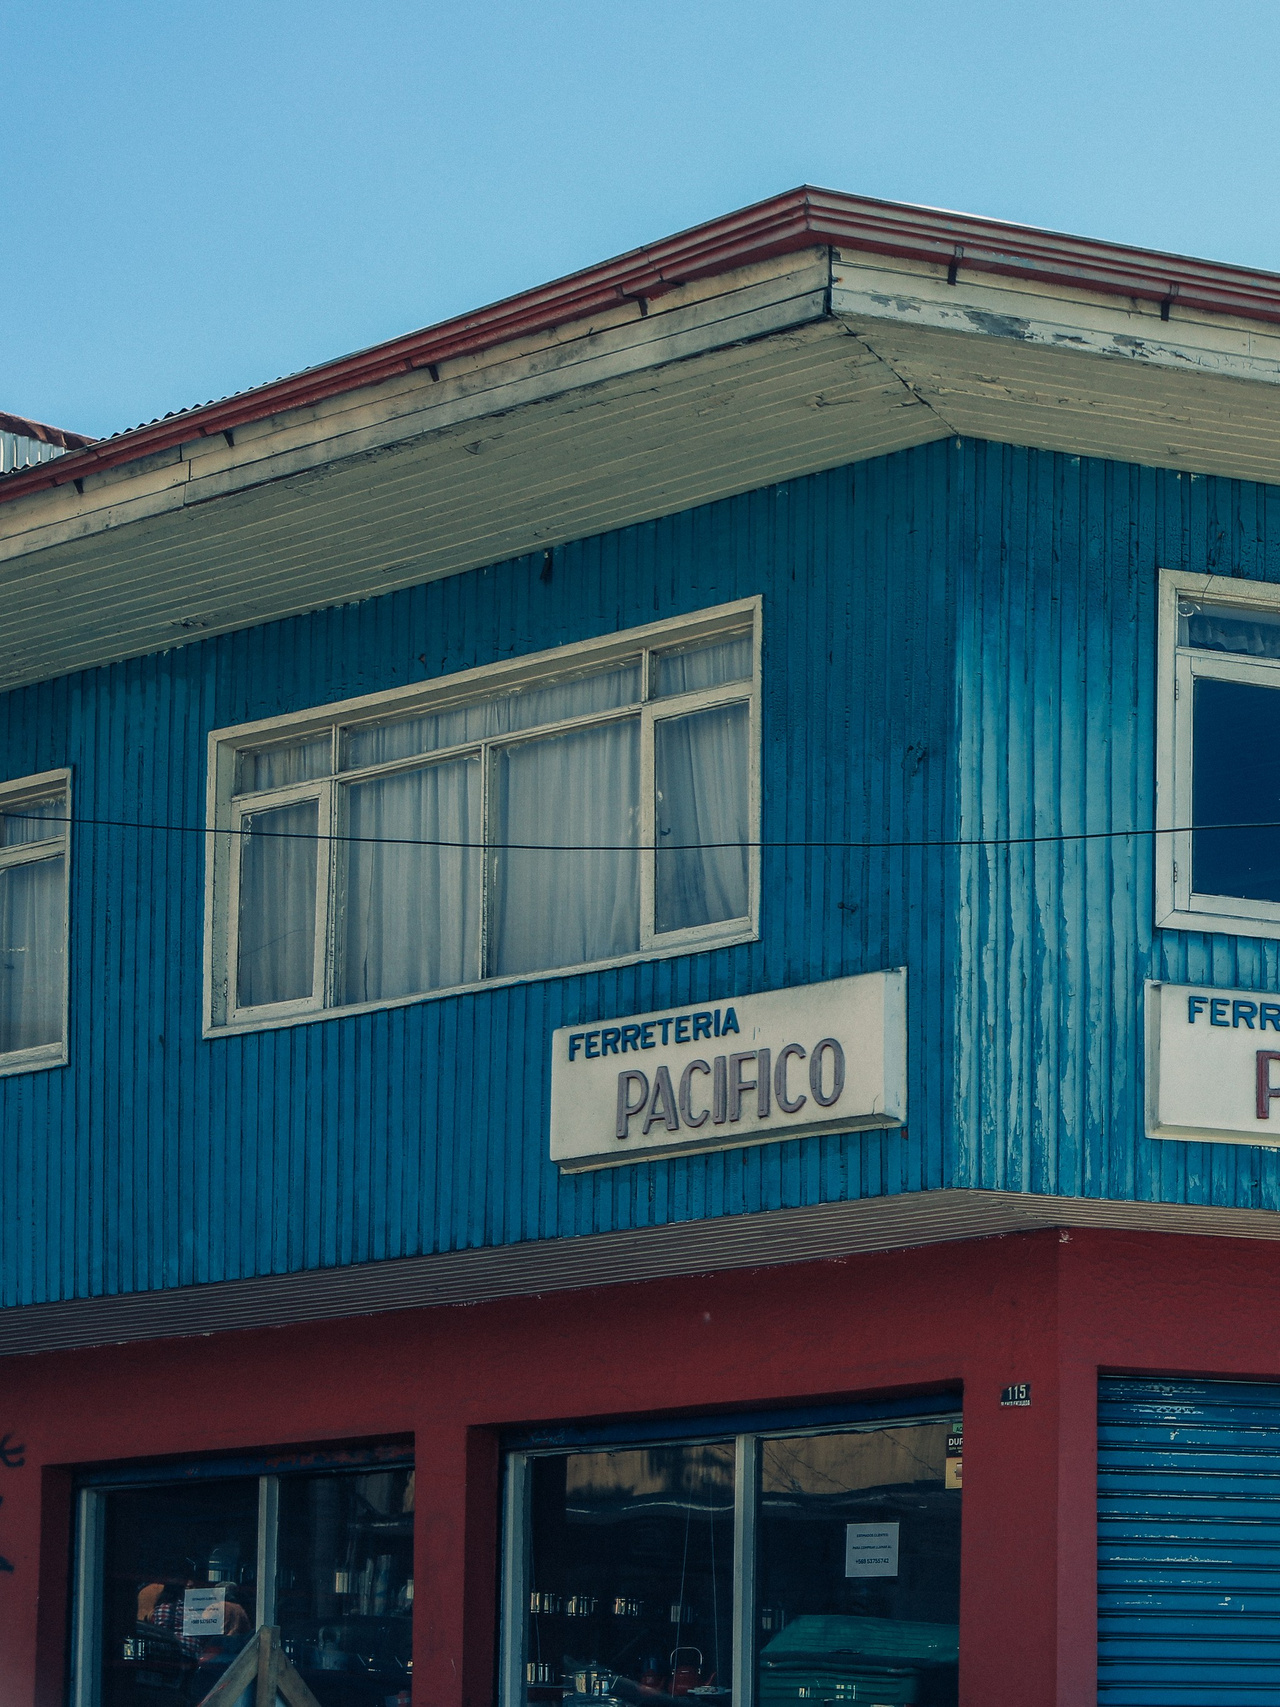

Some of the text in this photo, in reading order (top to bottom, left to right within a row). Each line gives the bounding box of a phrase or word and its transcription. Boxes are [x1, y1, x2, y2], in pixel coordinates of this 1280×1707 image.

[568, 1007, 740, 1063] FERRETERIA
[615, 1037, 846, 1140] PACIFICO
[1008, 1384, 1027, 1400] 115
